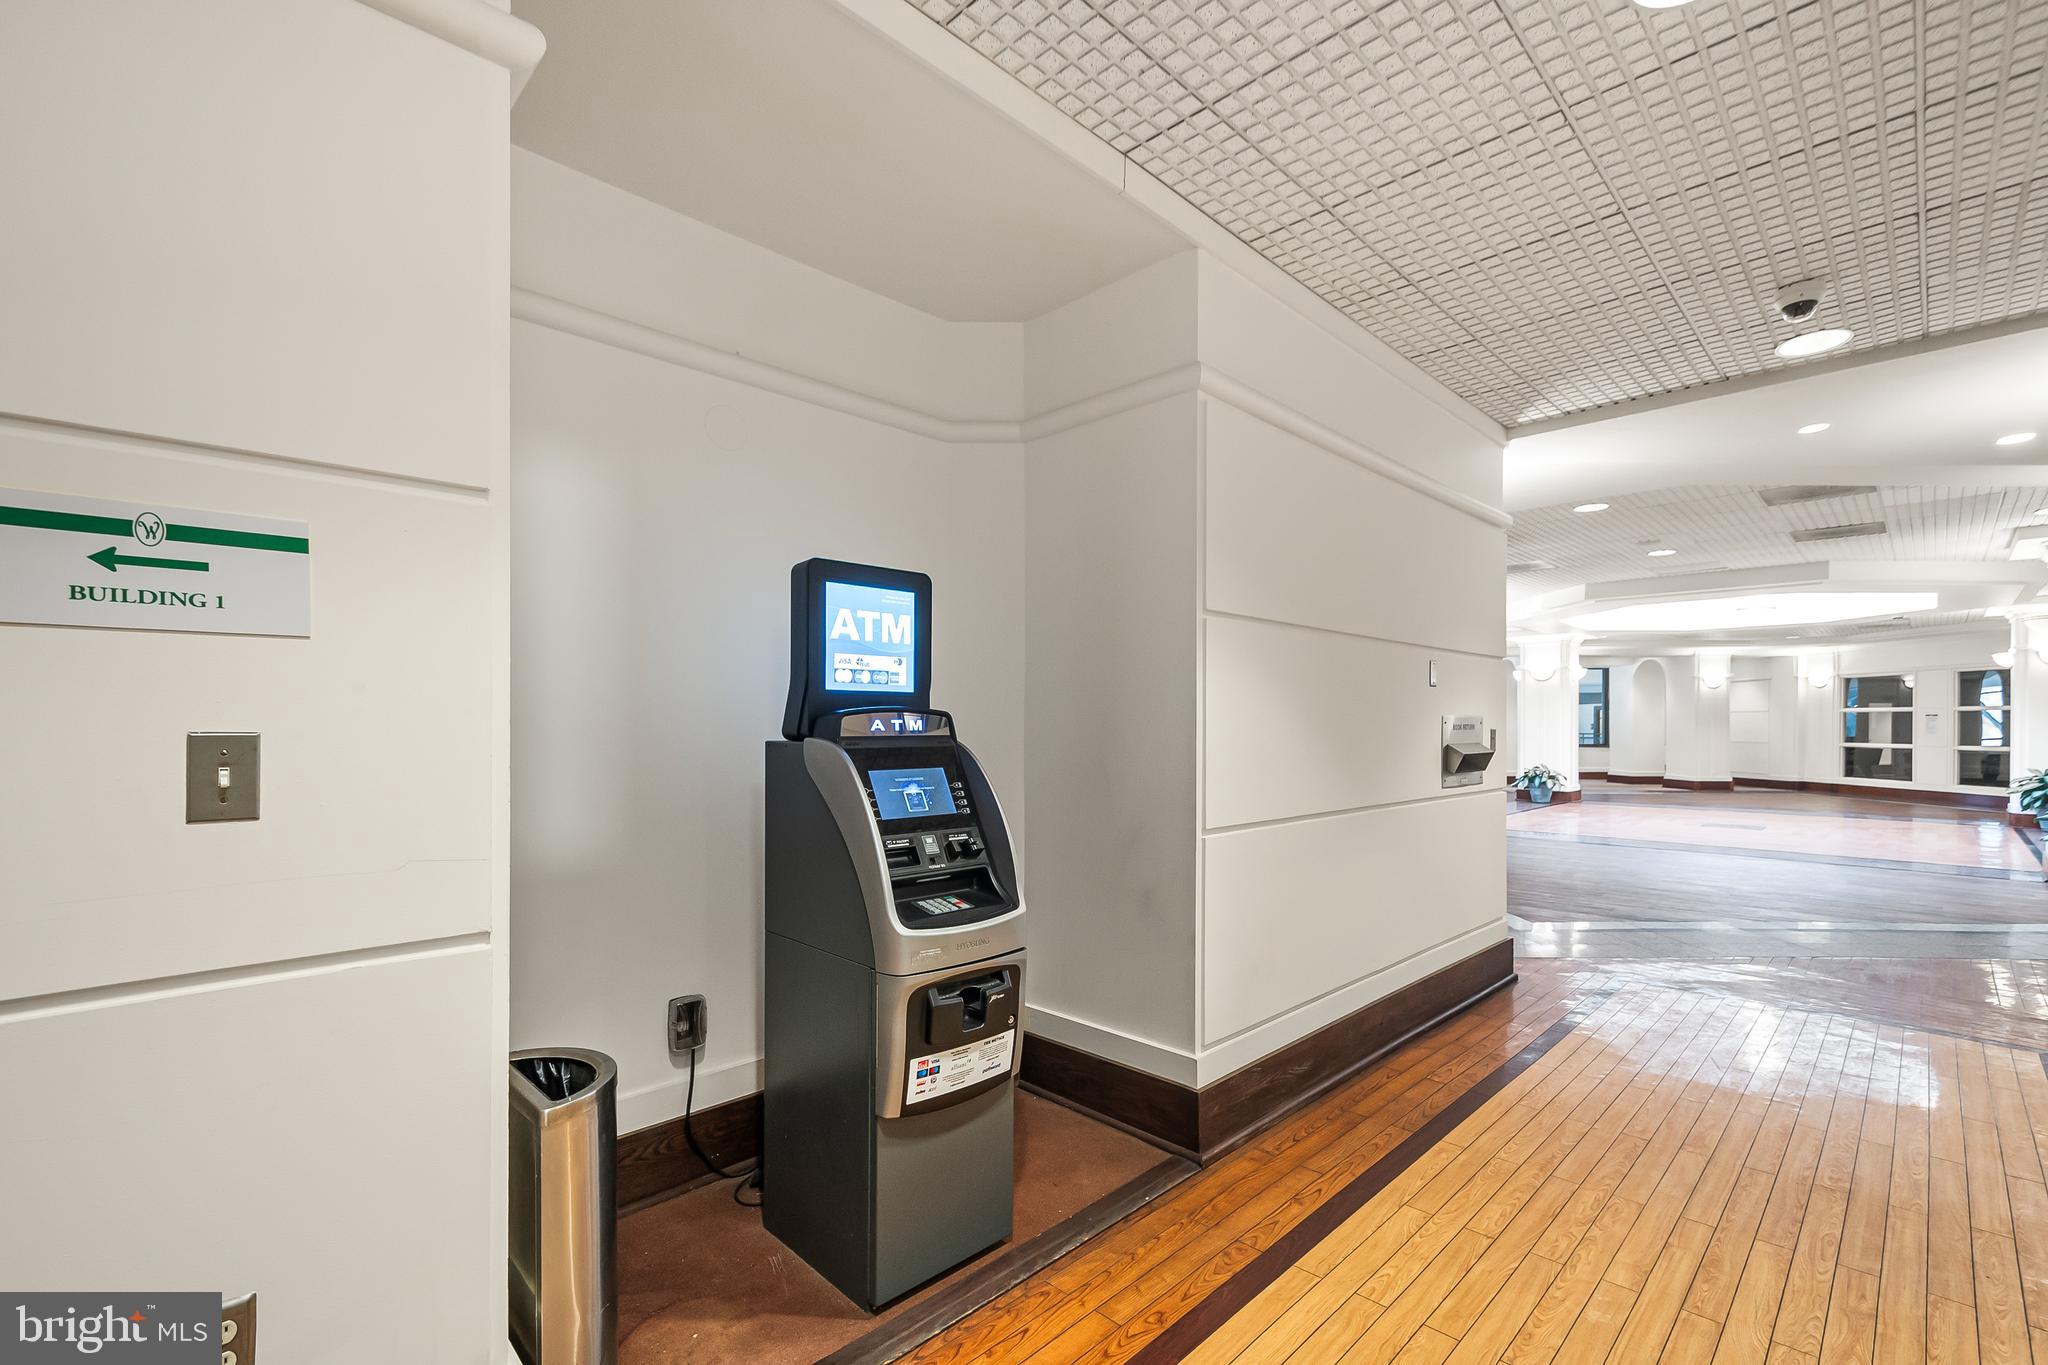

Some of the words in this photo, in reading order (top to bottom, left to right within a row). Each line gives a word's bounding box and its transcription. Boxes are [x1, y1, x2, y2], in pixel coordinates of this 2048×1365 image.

[68, 584, 207, 608] BUILDING
[215, 595, 226, 609] 1
[829, 607, 912, 645] ATM
[870, 719, 923, 732] ATM
